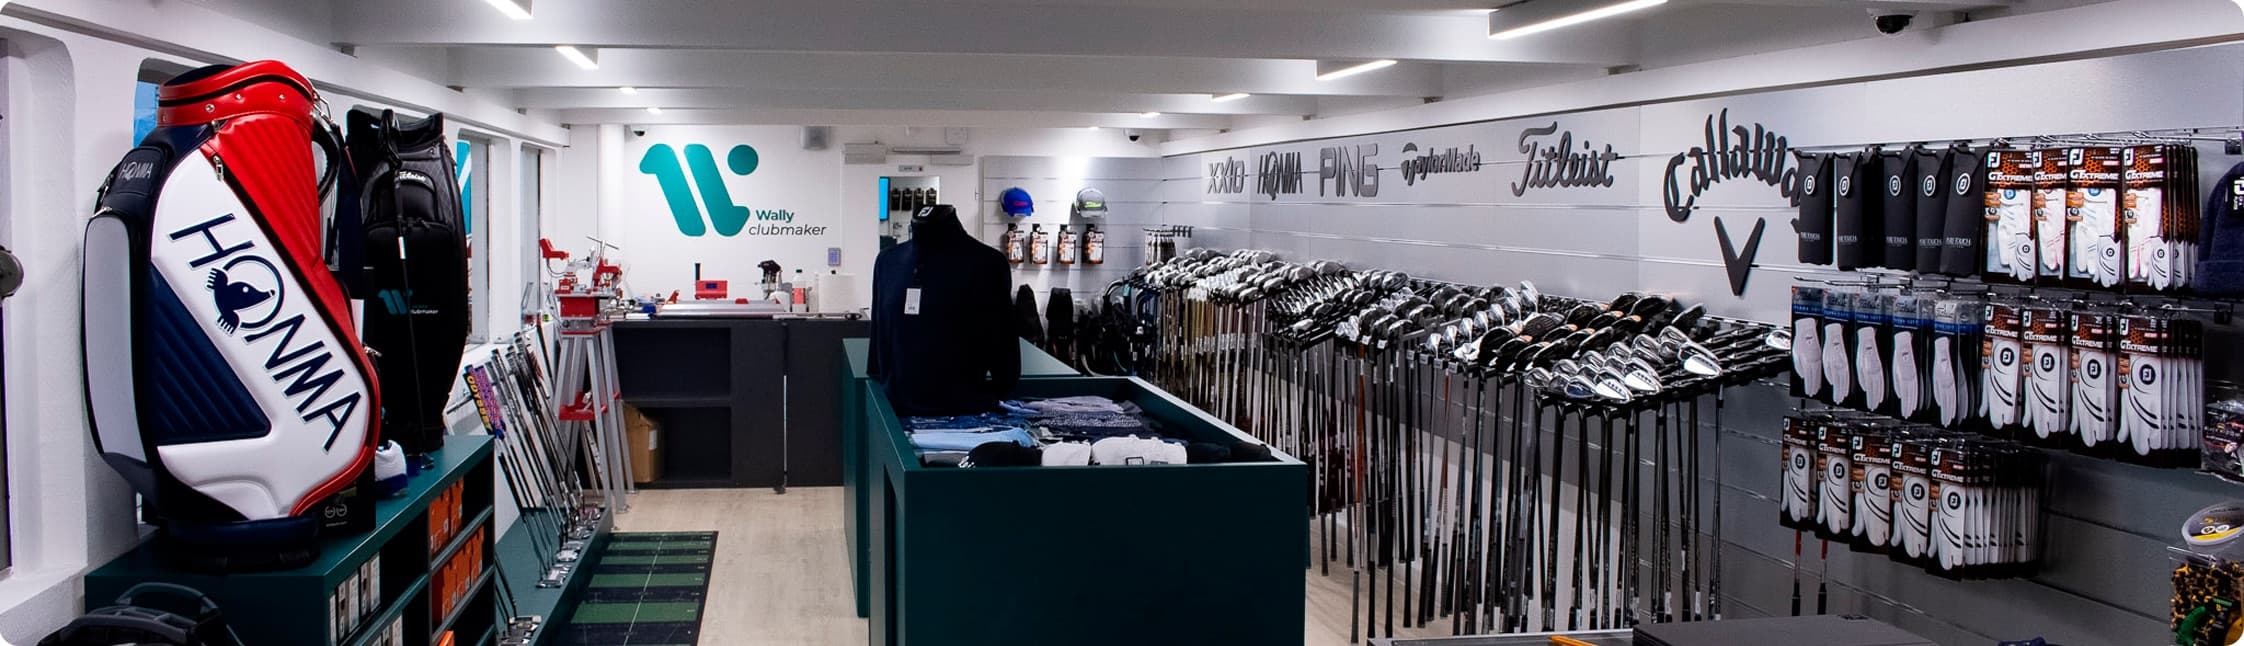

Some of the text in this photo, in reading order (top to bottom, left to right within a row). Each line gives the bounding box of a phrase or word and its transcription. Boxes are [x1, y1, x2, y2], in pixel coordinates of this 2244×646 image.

[118, 161, 154, 181] HONMA
[1257, 150, 1303, 201] HONMA
[1319, 143, 1379, 197] PING
[1400, 142, 1481, 186] TaylorMade
[1511, 121, 1618, 197] Titleist
[1663, 107, 1800, 233] Callawa
[749, 224, 827, 236] clubmaker
[756, 209, 795, 223] Wally
[168, 213, 361, 453] HONMA
